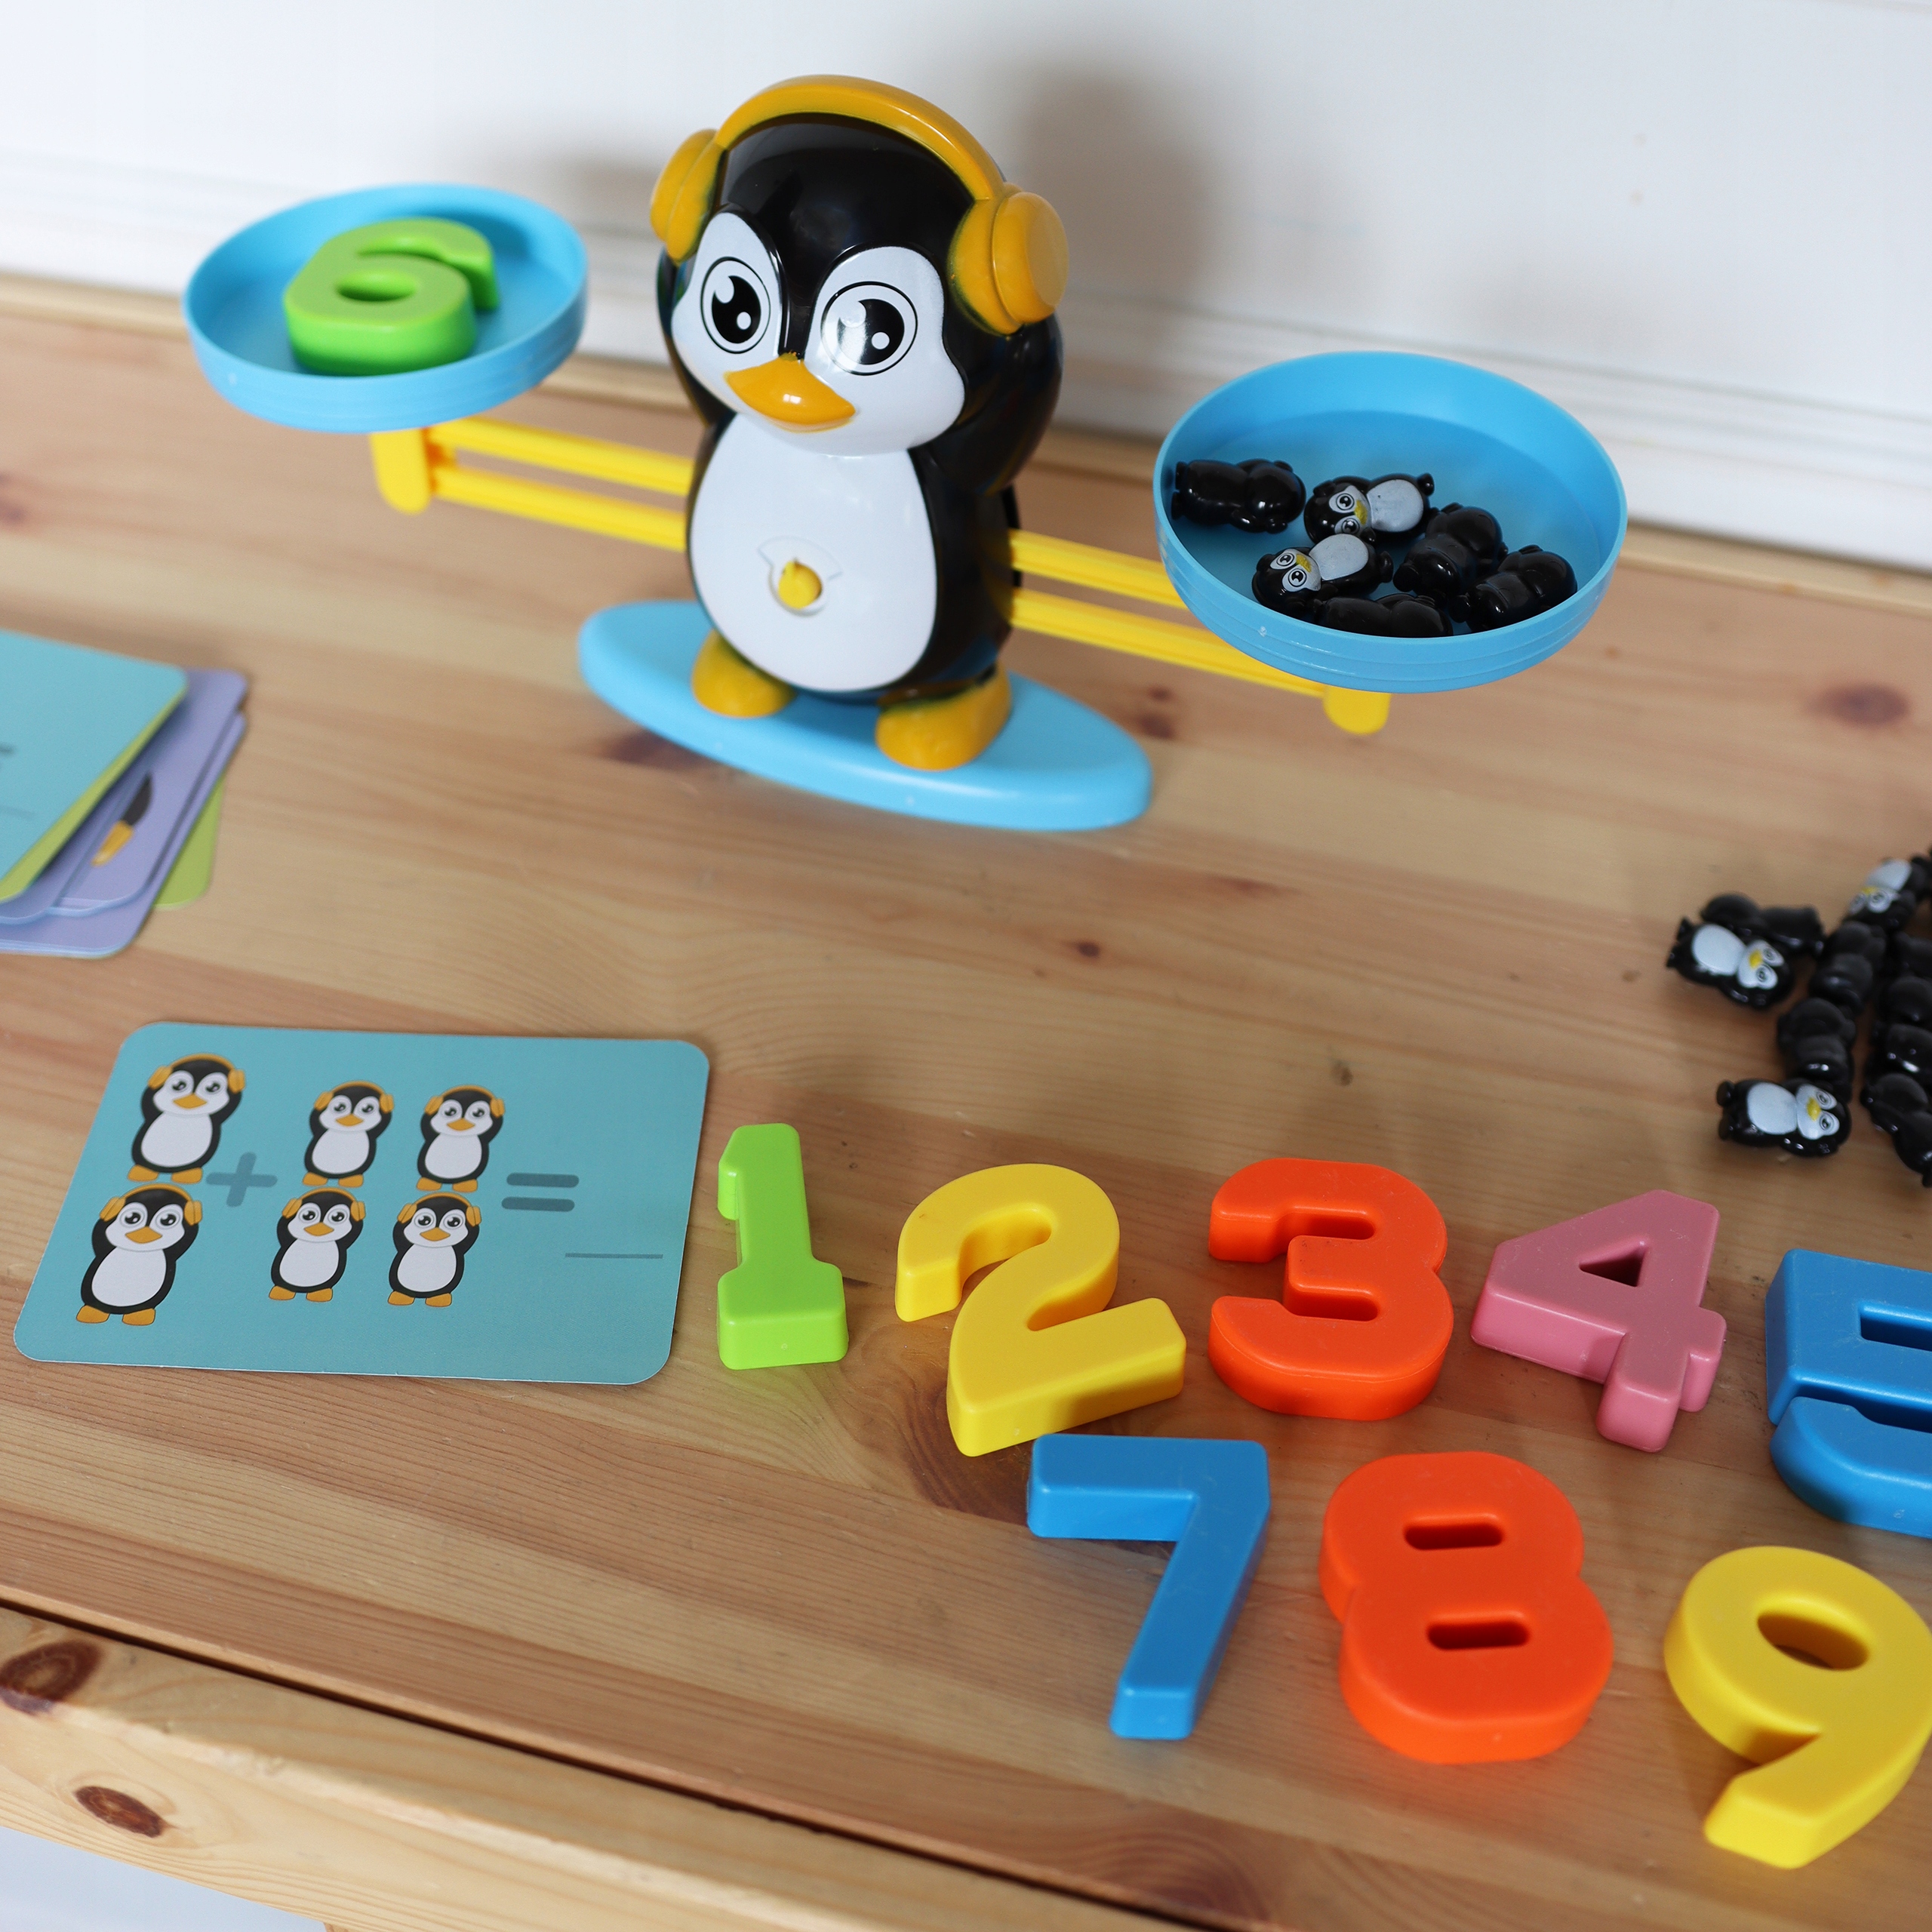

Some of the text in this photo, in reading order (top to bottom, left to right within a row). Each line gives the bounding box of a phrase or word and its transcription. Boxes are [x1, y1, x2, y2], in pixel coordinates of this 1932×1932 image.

[283, 216, 500, 376] 6
[717, 1121, 1932, 1540] 1 2 3 4 5
[1026, 1432, 1932, 1870] 7 8 9
